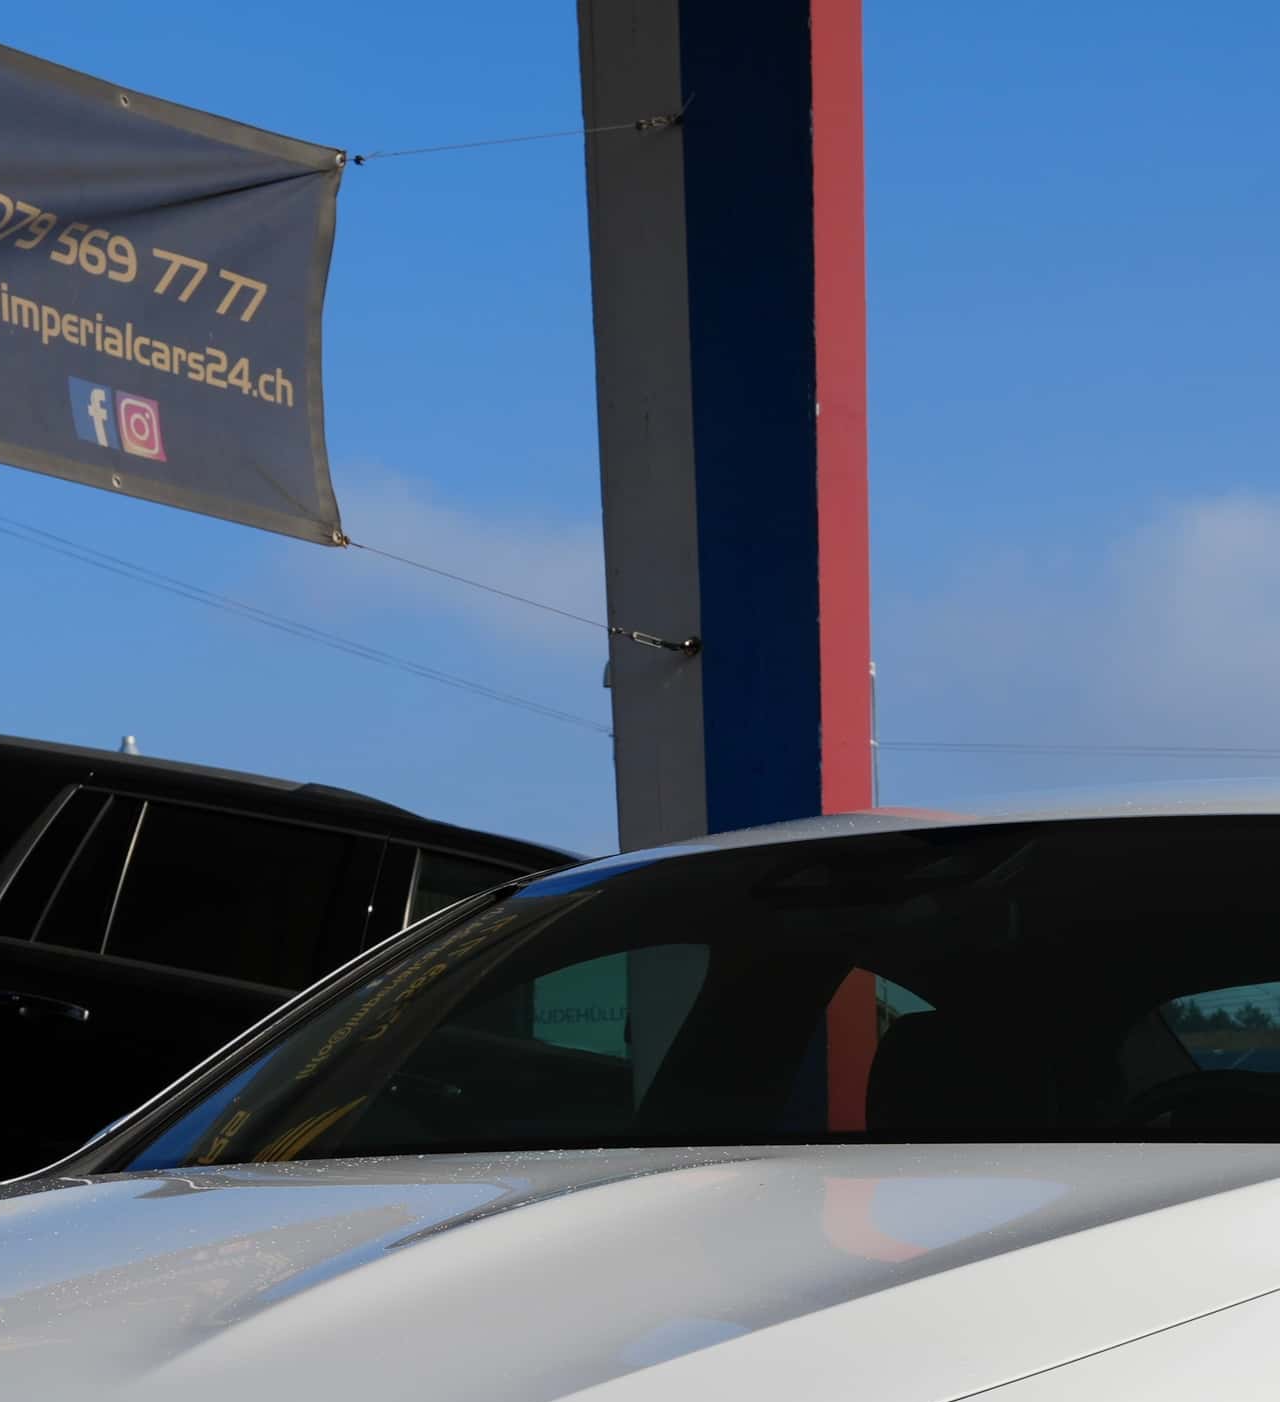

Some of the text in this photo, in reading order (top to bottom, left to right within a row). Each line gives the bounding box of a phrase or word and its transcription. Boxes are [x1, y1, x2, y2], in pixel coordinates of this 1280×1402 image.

[50, 222, 138, 284] 569
[152, 247, 208, 303] 77
[215, 269, 268, 322] 77
